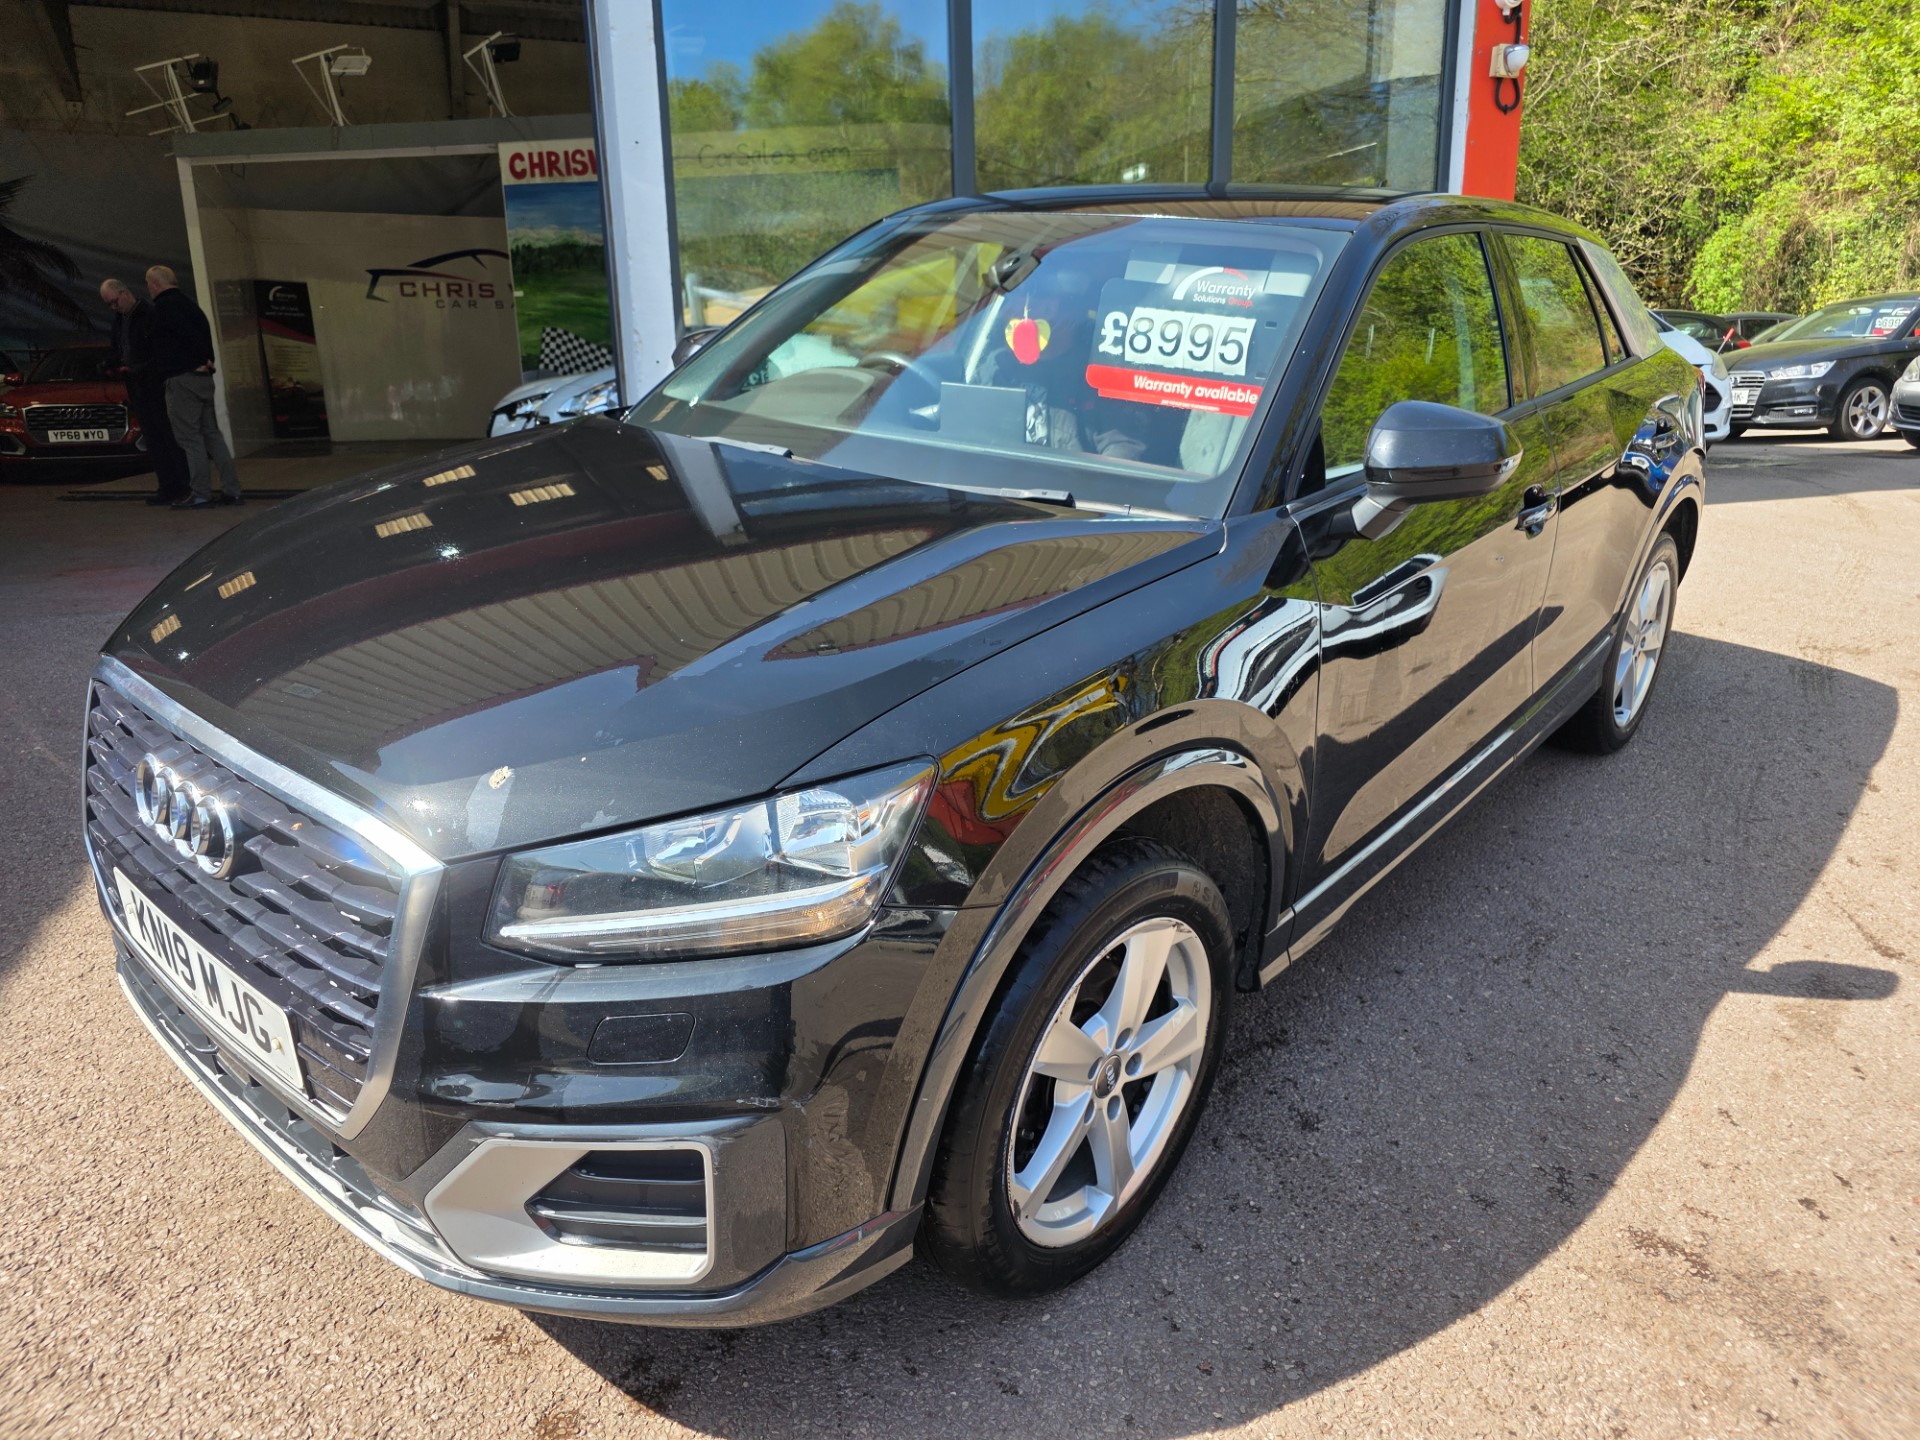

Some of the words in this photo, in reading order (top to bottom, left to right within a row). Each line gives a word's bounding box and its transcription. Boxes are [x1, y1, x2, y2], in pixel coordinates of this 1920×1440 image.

[400, 281, 495, 298] CHRIS
[1197, 280, 1256, 300] Warranty
[435, 300, 478, 309] CAR
[1193, 293, 1226, 304] Solutions
[1228, 297, 1253, 308] Group
[1099, 311, 1247, 366] £8995
[1134, 375, 1193, 399] Warranty
[1194, 386, 1258, 405] available
[53, 431, 80, 441] YP68
[130, 888, 197, 991] KN19
[197, 951, 273, 1054] MJG
